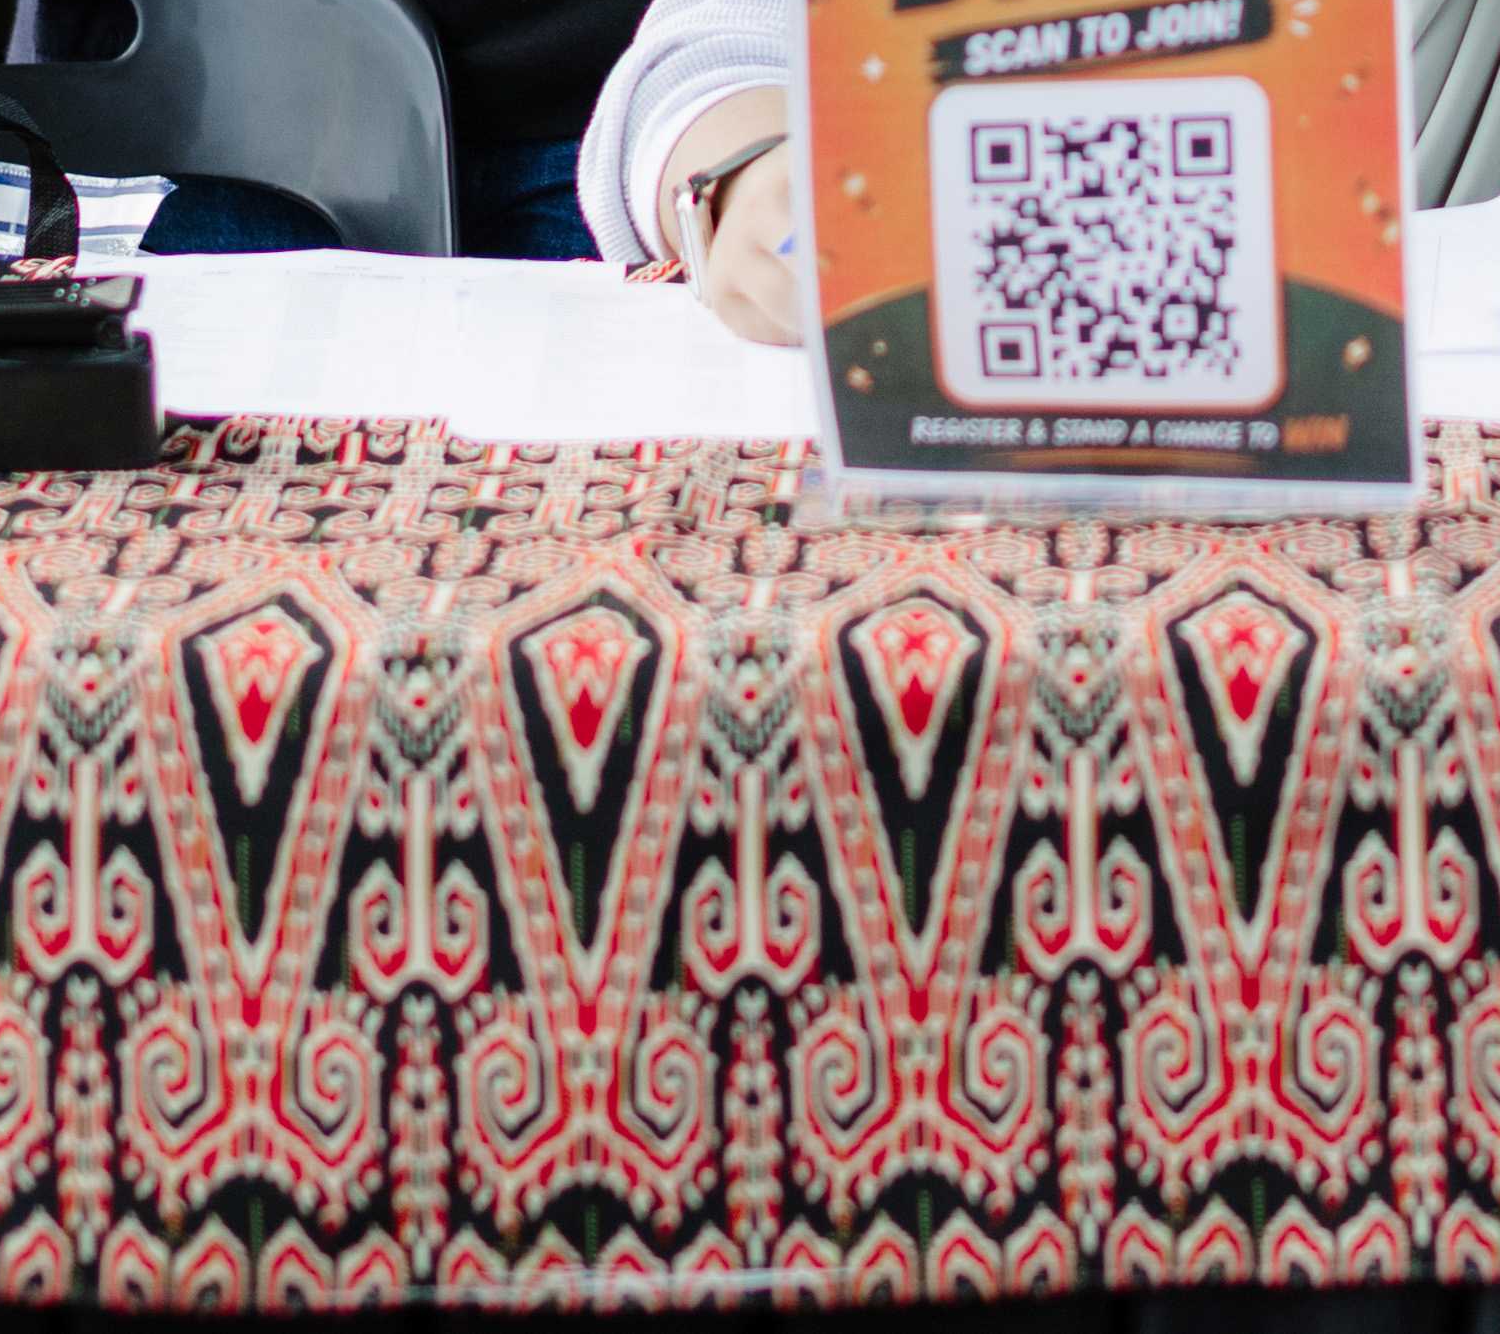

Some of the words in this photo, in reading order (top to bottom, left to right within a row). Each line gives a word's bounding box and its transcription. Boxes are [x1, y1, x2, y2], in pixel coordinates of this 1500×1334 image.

[963, 20, 1070, 75] SCAN
[1078, 12, 1131, 56] TO
[911, 415, 1022, 444] REGISTER
[1025, 416, 1048, 446] &
[1051, 416, 1128, 446] STAND
[1129, 418, 1151, 447] A
[1153, 419, 1243, 449] CHANCE
[1247, 419, 1279, 449] TO
